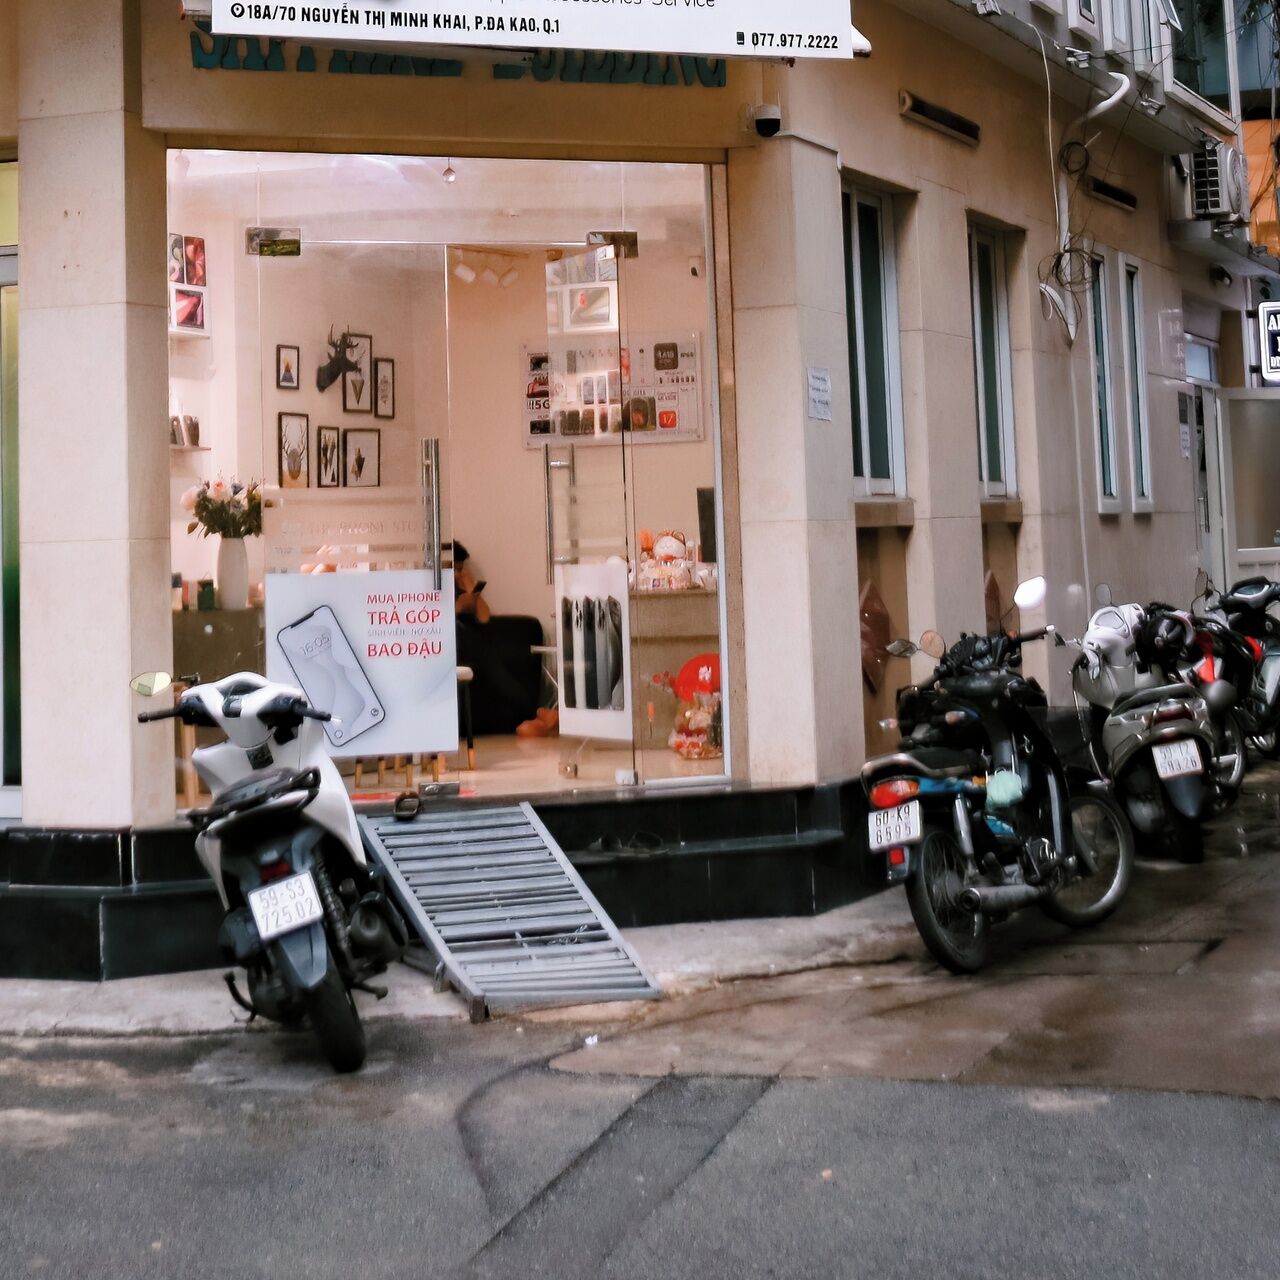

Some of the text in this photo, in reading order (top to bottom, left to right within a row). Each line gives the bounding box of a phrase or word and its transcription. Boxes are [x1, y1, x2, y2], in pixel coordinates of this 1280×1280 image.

[247, 4, 297, 22] 18A/70
[301, 1, 360, 25] NGUYỄN
[364, 10, 387, 29] THỊ
[390, 10, 429, 29] MINH
[433, 12, 471, 33] KHAI,
[543, 17, 561, 35] Q.1
[750, 32, 840, 51] 077.977.2222
[367, 592, 441, 605] MUA IPHONE
[368, 605, 442, 626] TRẢ GÓP
[368, 637, 443, 659] BAO ĐẬU
